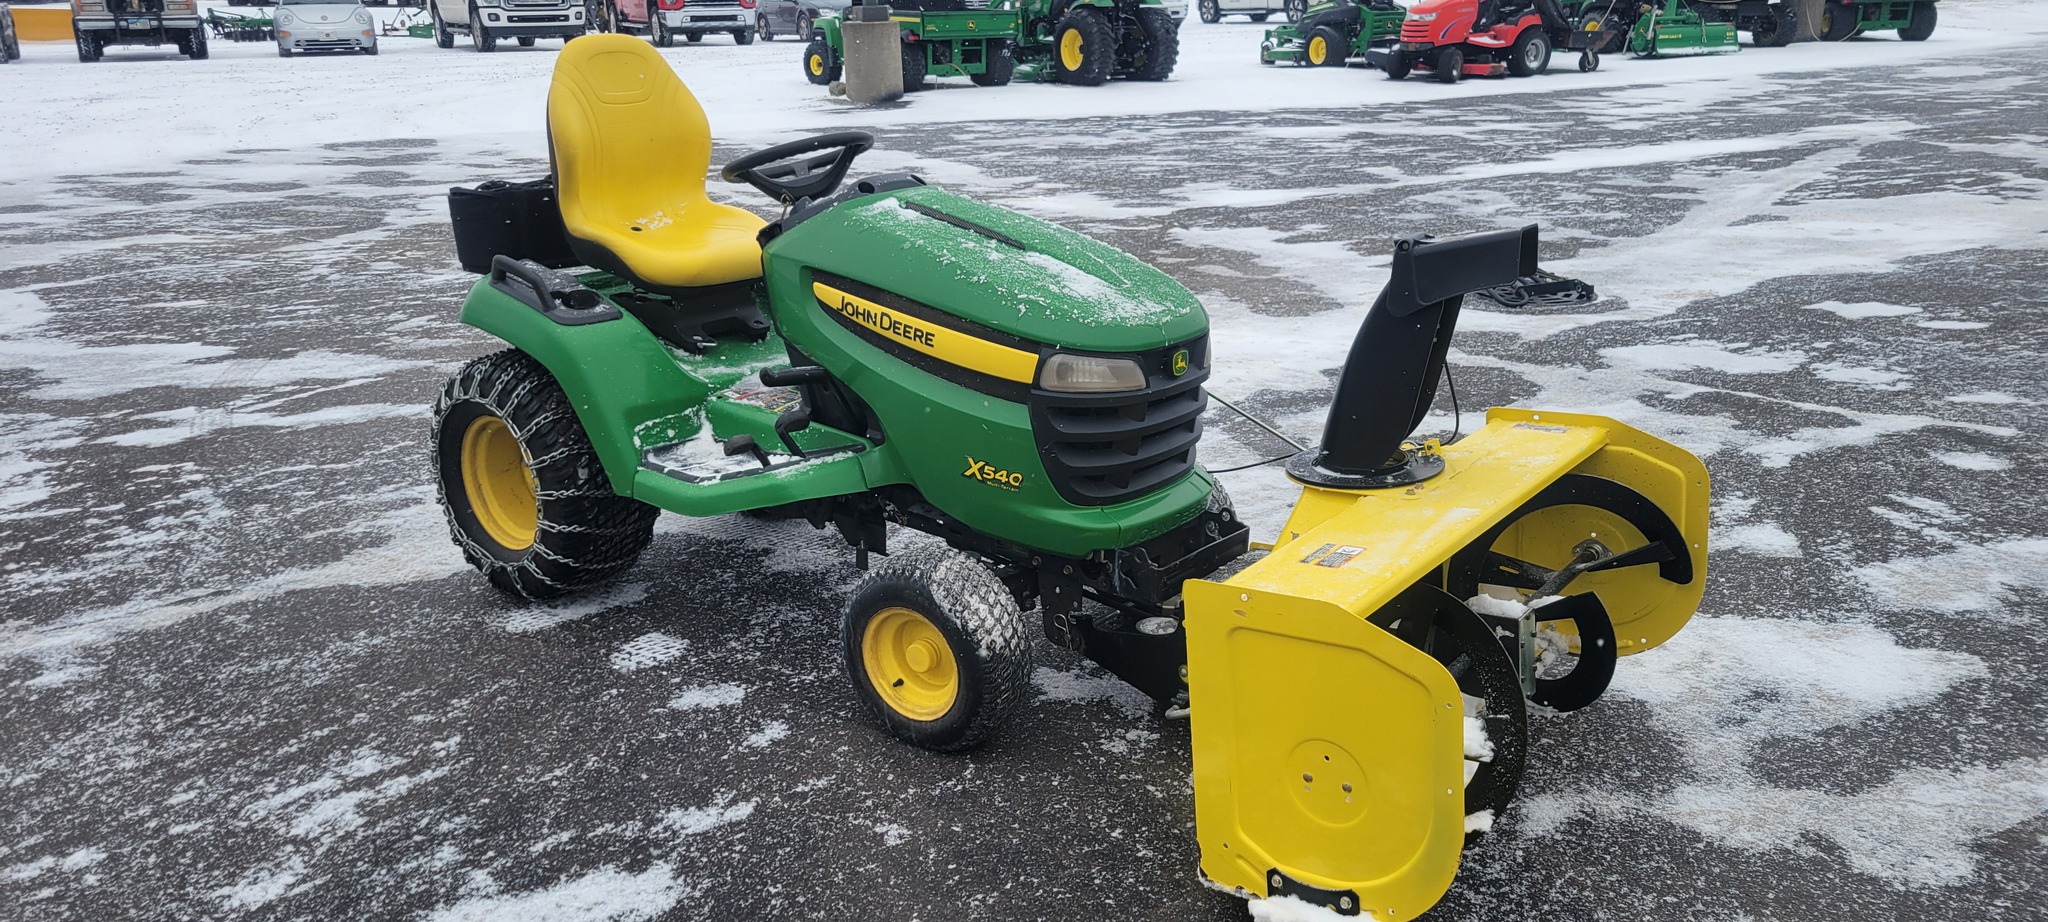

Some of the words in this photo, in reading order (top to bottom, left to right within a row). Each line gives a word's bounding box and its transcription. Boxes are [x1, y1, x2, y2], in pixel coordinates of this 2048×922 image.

[836, 296, 878, 327] JOHN
[880, 311, 936, 348] DEERE
[964, 456, 1023, 487] X540
